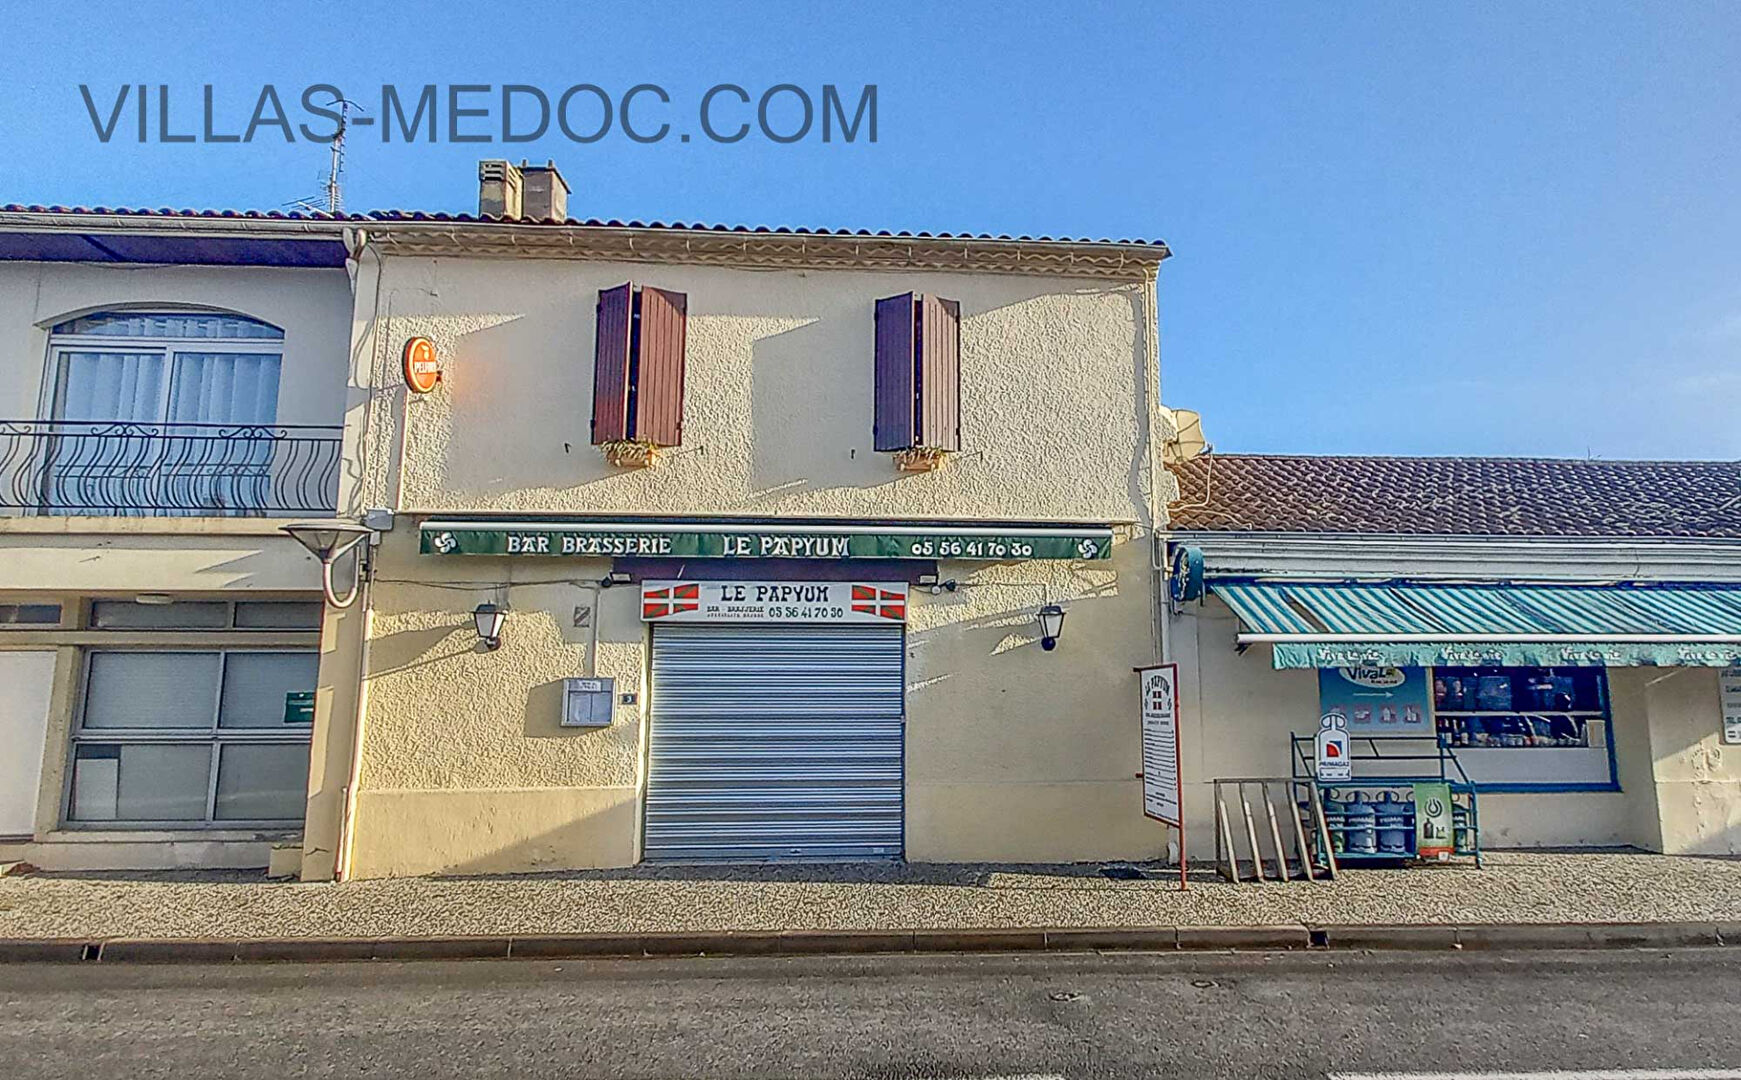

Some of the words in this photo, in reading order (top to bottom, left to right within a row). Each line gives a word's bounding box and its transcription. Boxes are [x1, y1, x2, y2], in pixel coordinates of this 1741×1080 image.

[507, 536, 550, 554] BAR
[562, 536, 672, 554] BRASSERIE
[723, 536, 751, 556] LE
[759, 536, 850, 557] PAPYUM
[911, 542, 934, 556] 05
[939, 542, 962, 556] 56
[966, 542, 983, 556] 41
[988, 542, 1007, 556] 70
[1011, 543, 1033, 556] 30
[721, 585, 746, 602] LE
[756, 585, 830, 603] PAPYUM
[768, 606, 783, 618] 05
[785, 607, 799, 619] 56
[801, 606, 812, 618] 41
[814, 607, 828, 618] 70
